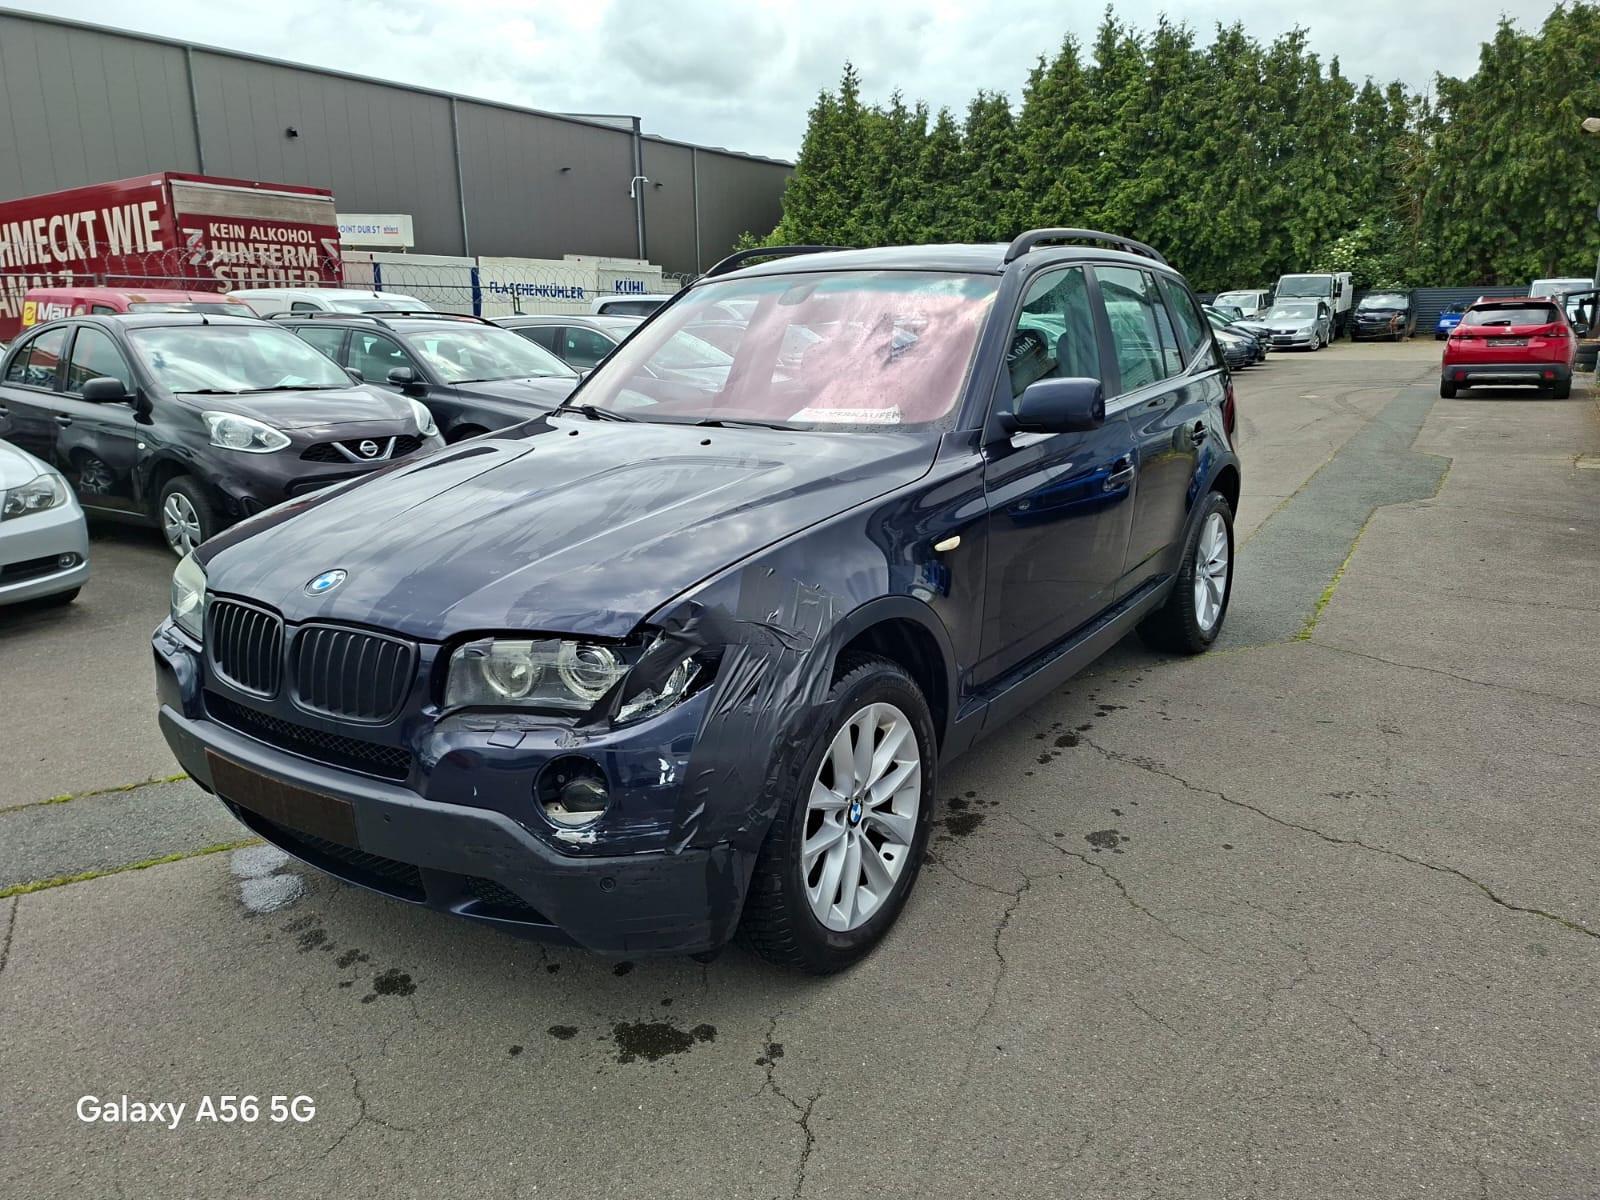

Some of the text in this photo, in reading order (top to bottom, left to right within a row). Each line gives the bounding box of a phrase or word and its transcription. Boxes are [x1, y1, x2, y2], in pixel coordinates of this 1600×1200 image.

[102, 201, 163, 256] WIE
[209, 222, 316, 244] KEIN ALKOHOL
[212, 240, 319, 268] HINTERM
[489, 281, 585, 300] FLASCHENKÜHLER
[615, 277, 648, 295] KÜHL
